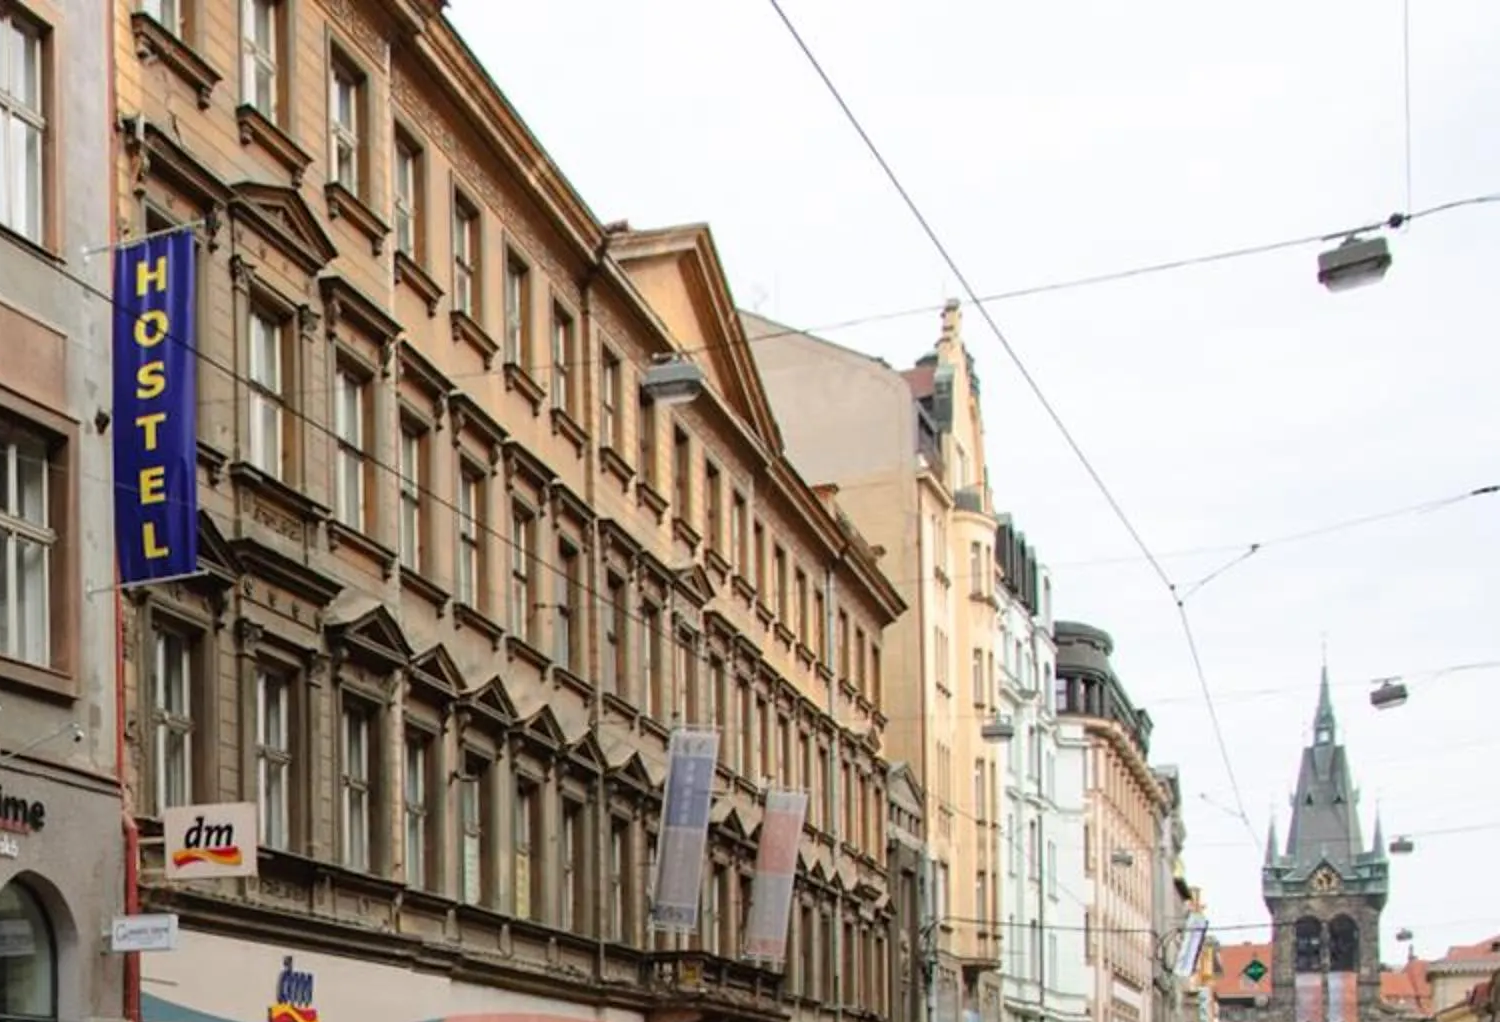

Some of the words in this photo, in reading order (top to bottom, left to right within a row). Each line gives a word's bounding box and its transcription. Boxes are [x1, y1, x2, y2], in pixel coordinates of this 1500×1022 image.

[133, 255, 170, 562] HOSTEL
[183, 816, 234, 850] dm
[277, 955, 313, 1007] dm
